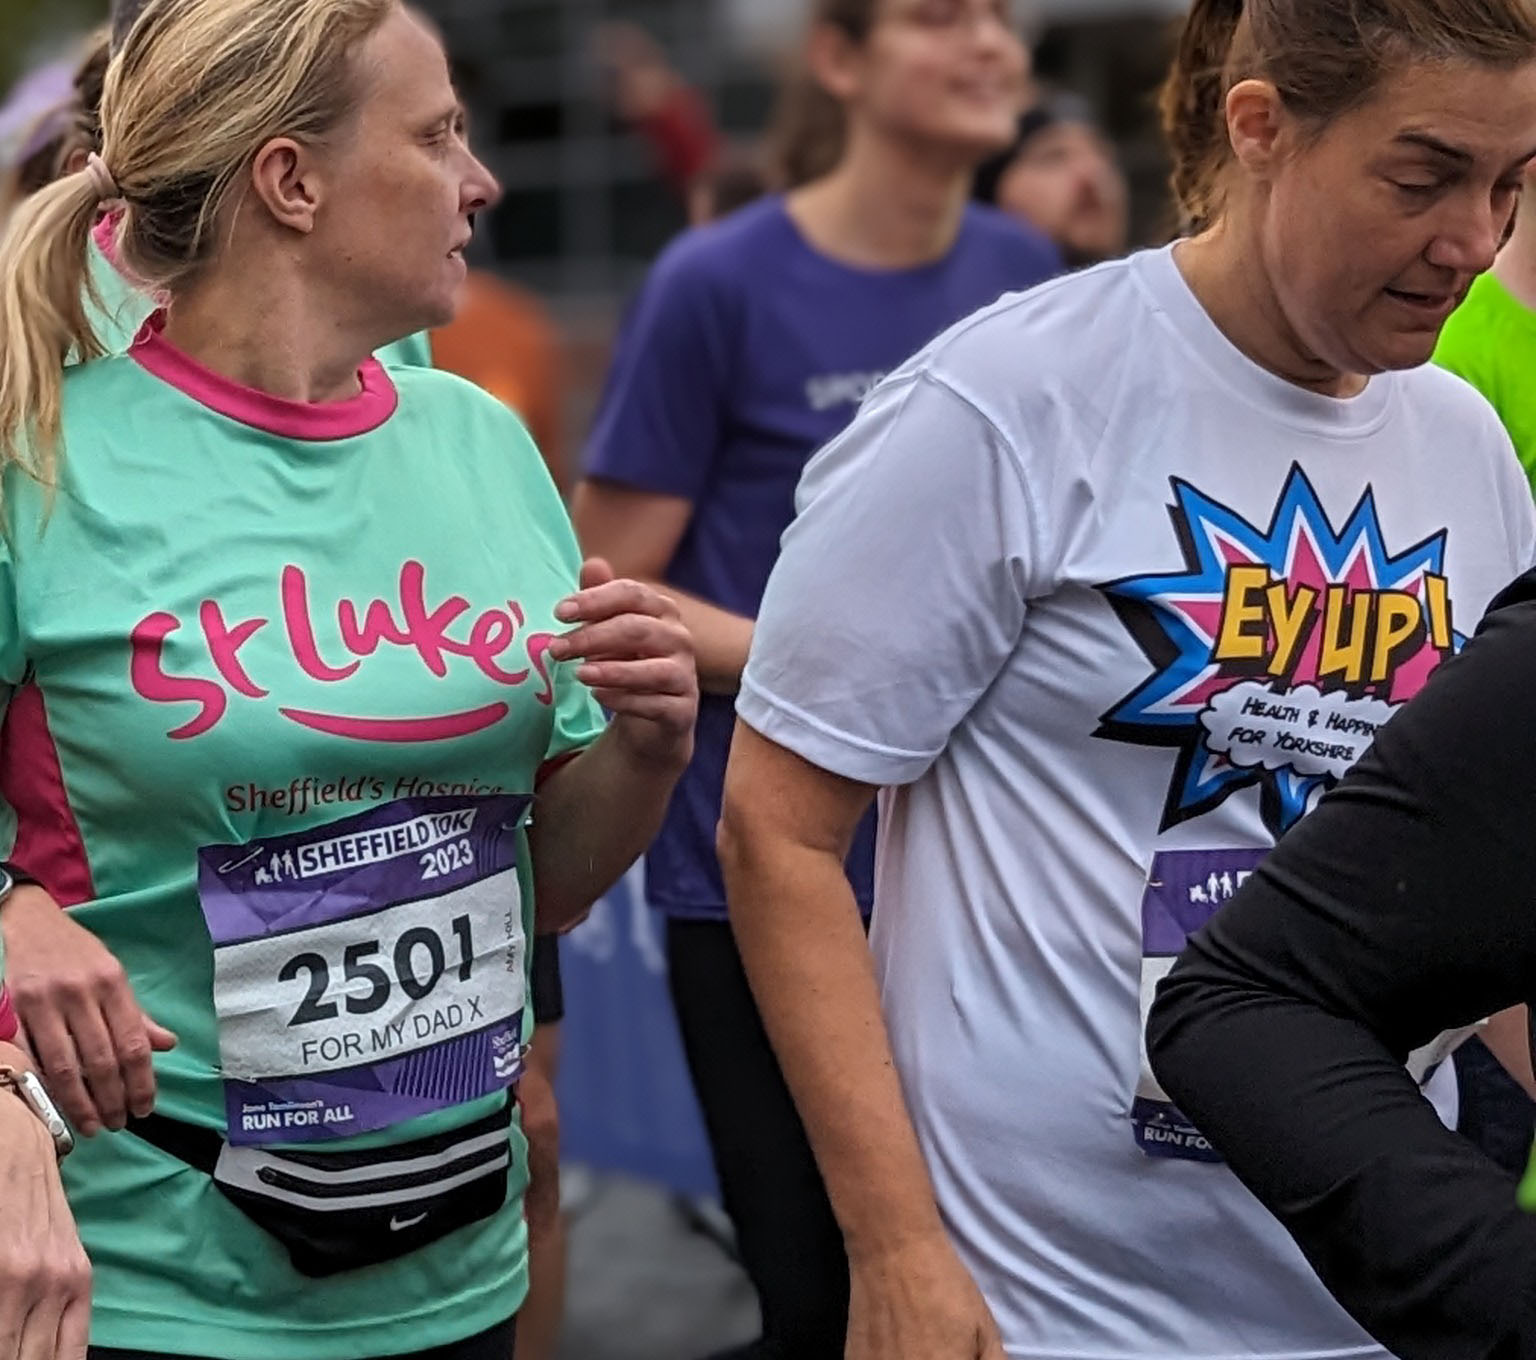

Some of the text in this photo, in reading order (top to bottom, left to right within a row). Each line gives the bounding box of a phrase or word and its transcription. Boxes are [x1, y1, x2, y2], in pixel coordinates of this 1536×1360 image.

[130, 599, 270, 740] St
[1241, 697, 1300, 723] HEALTH
[1228, 727, 1355, 760] FOR YORKSHIRE
[226, 775, 383, 816] Sheffield's
[301, 812, 470, 872] SHEFFIELD 10K
[419, 838, 473, 880] 2023
[279, 914, 475, 1028] 2501
[303, 995, 484, 1065] FOR MY DAD X
[242, 1105, 354, 1130] RUN FOR ALL
[1144, 1126, 1182, 1145] RUN
